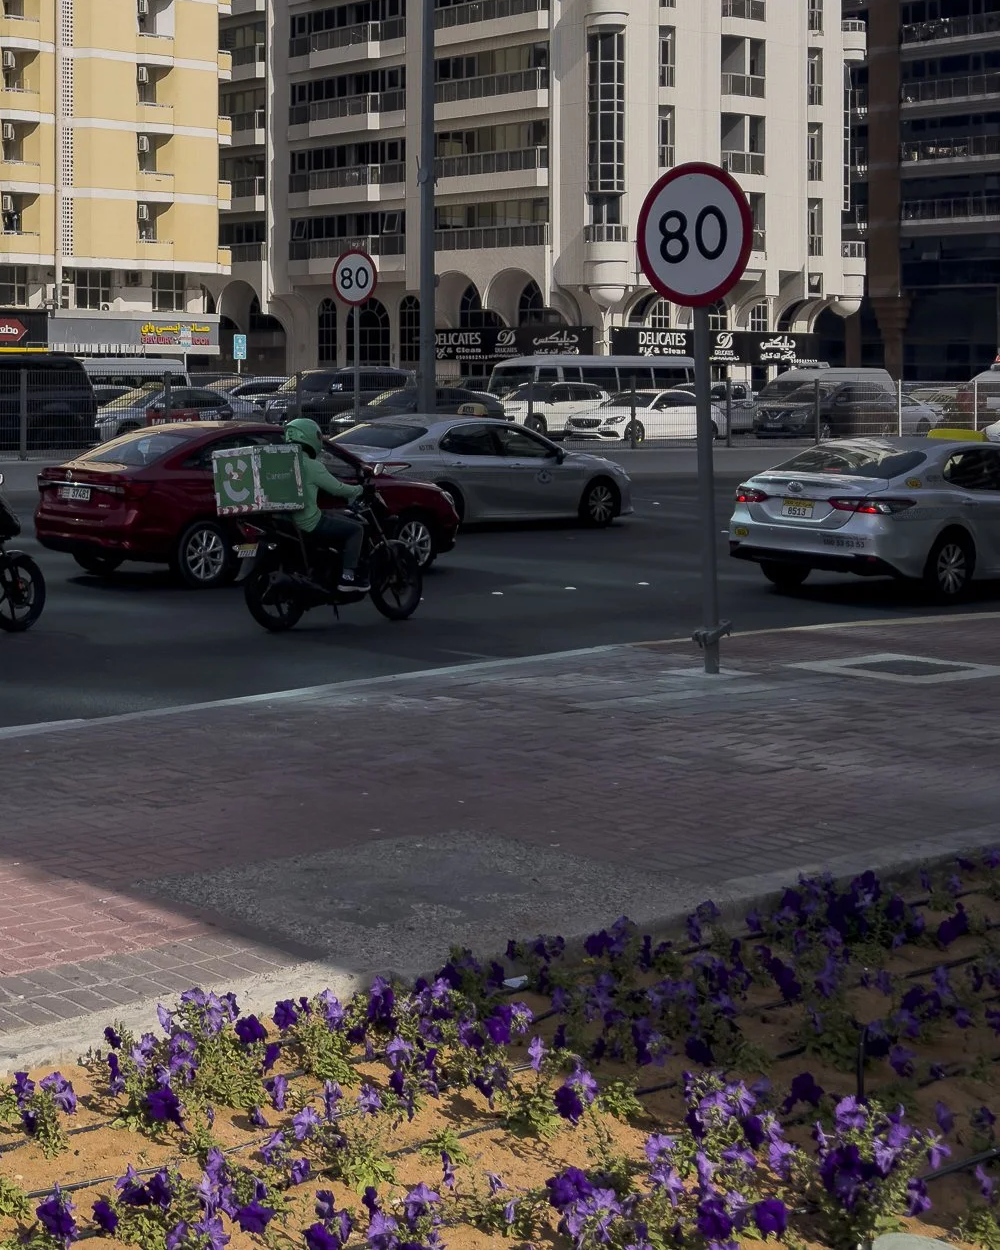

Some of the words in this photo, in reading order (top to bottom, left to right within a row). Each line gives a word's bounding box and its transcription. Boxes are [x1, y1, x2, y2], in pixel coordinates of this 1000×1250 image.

[659, 205, 727, 264] 80
[341, 267, 368, 289] 80
[639, 331, 686, 346] DELICATES
[787, 506, 807, 516] 8513
